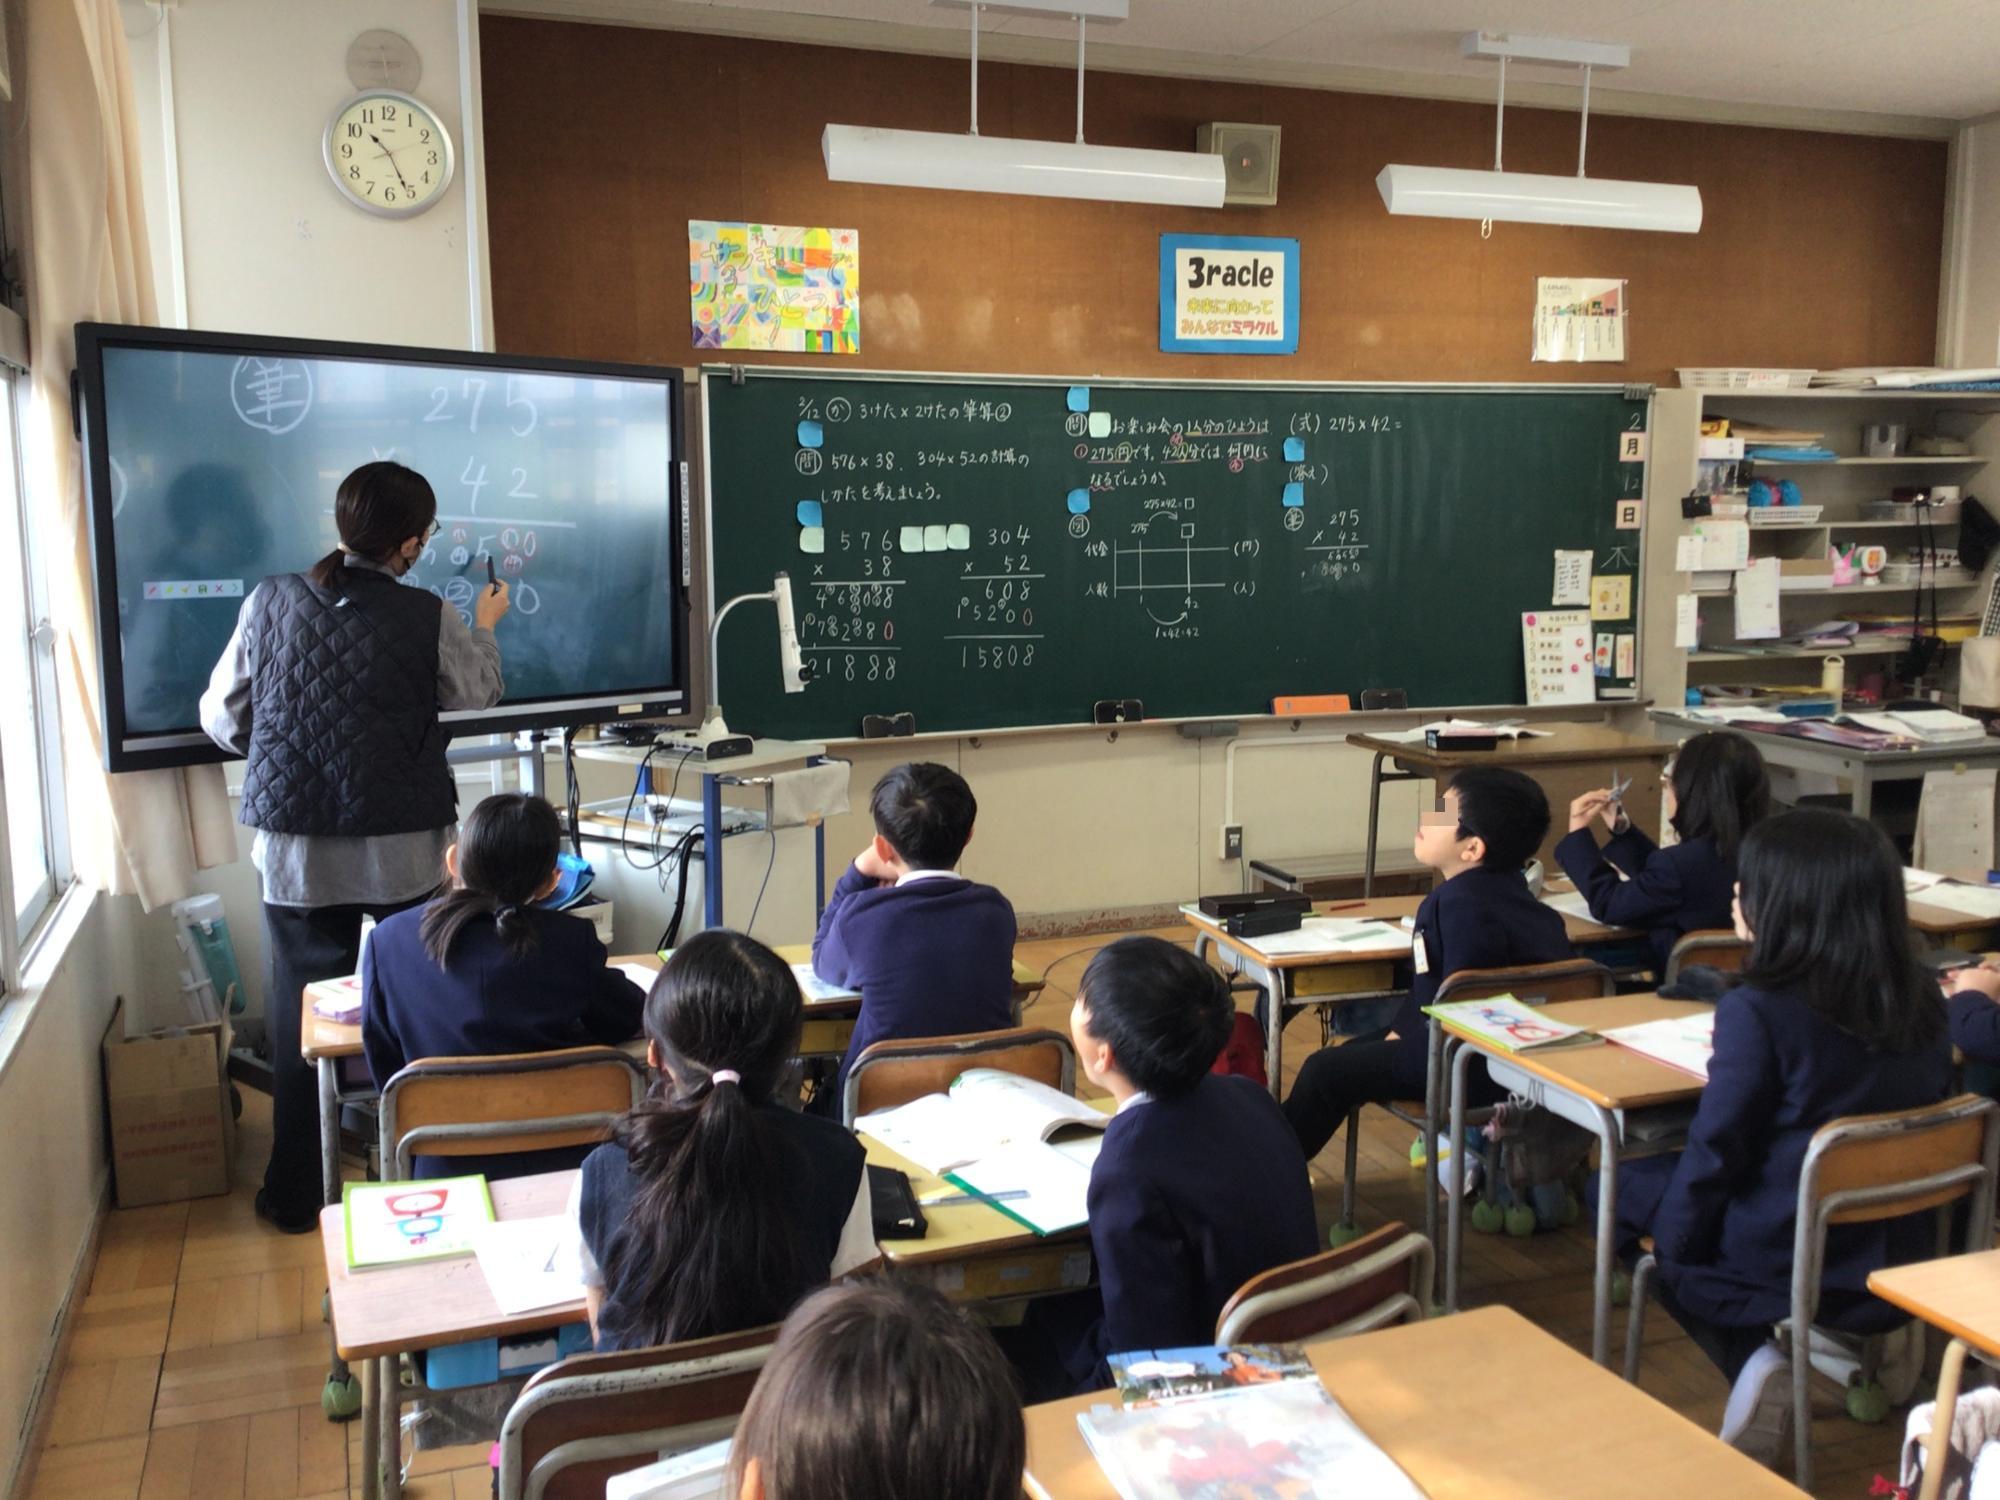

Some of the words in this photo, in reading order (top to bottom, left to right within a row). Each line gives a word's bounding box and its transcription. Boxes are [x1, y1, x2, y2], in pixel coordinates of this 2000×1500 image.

[362, 109, 374, 124] 11
[381, 105, 396, 121] 12
[407, 113, 413, 127] 1
[347, 123, 363, 138] 10
[420, 129, 430, 144] 2
[341, 144, 353, 158] 9
[427, 151, 437, 165] 3
[350, 166, 361, 180] 8
[420, 170, 429, 184] 4
[366, 181, 375, 195] 7
[384, 187, 396, 201] 6
[406, 185, 416, 199] 5
[1188, 256, 1274, 289] 3racle
[1181, 318, 1278, 336] みんなでミラクル
[1628, 412, 1642, 430] 2
[1626, 437, 1639, 456] 月
[1624, 475, 1640, 491] 12
[1622, 506, 1636, 523] 日
